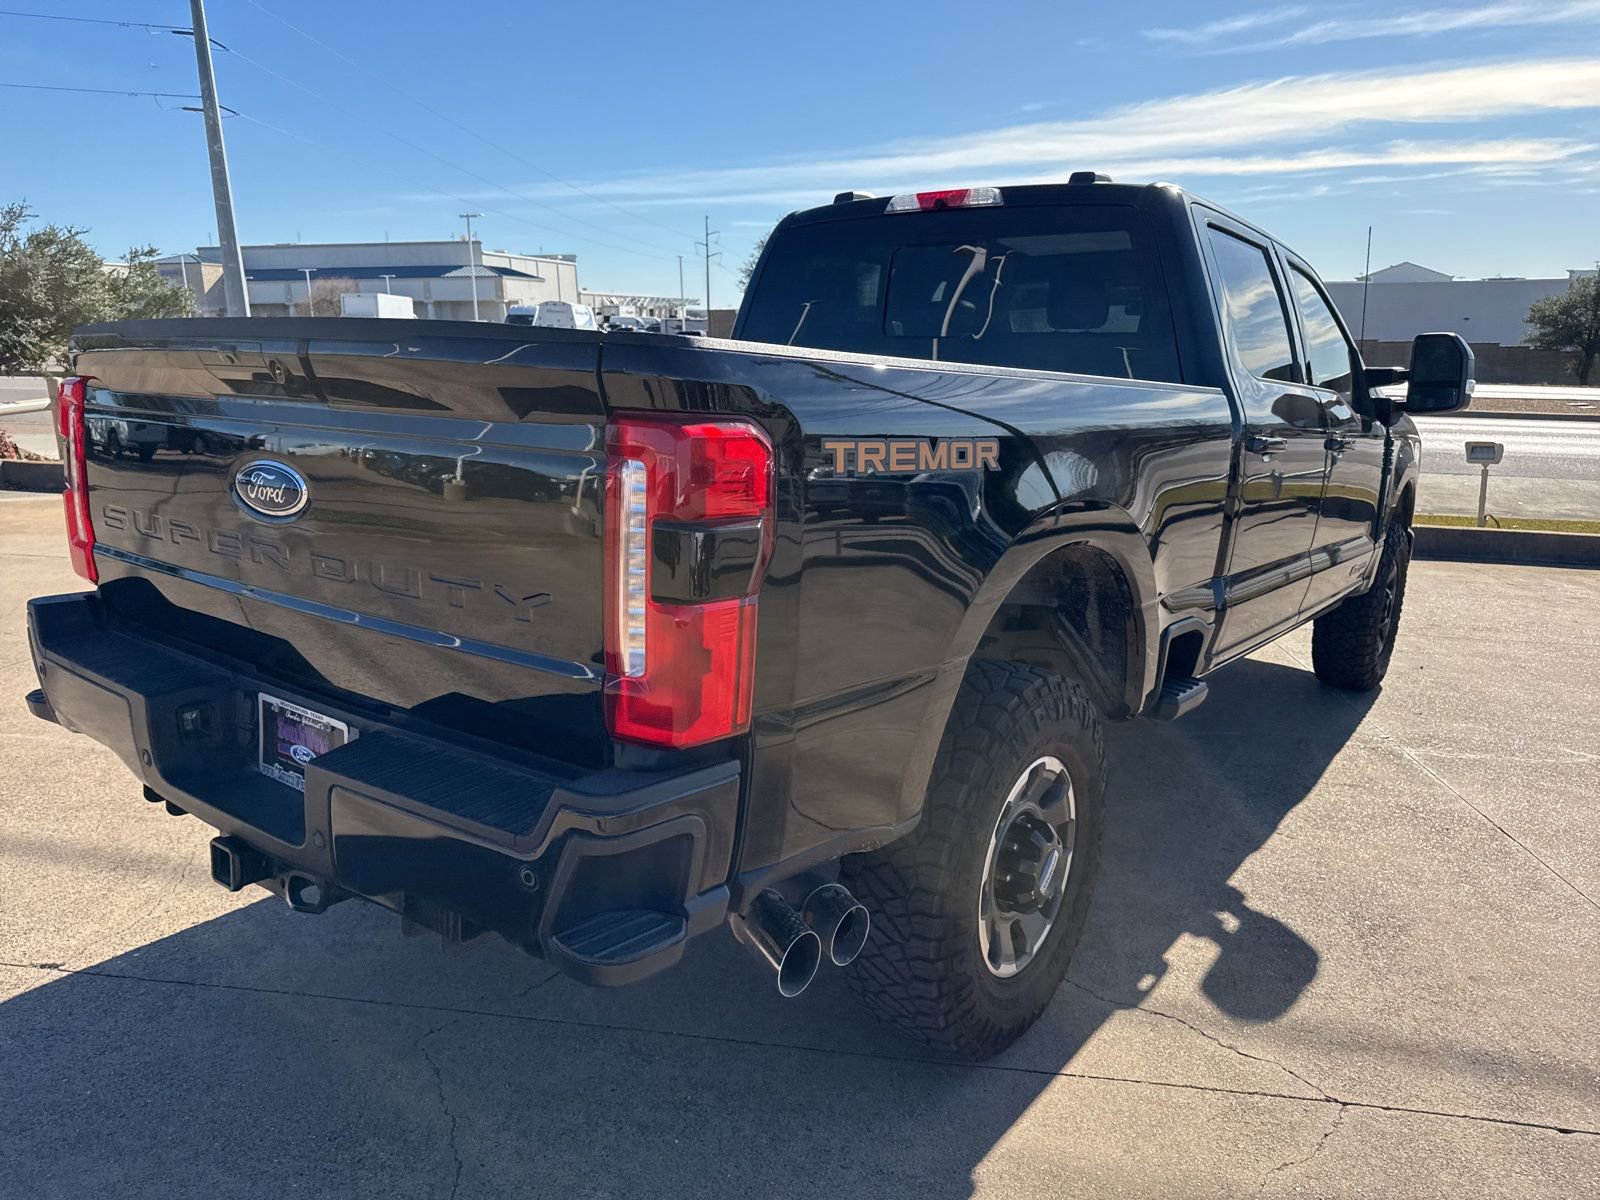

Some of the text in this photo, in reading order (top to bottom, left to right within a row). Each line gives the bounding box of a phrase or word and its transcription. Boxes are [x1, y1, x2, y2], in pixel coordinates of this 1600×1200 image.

[822, 439, 1001, 476] TREMOR
[247, 471, 286, 504] Ford
[102, 504, 552, 623] SUPER DUTY
[295, 746, 312, 763] Ford
